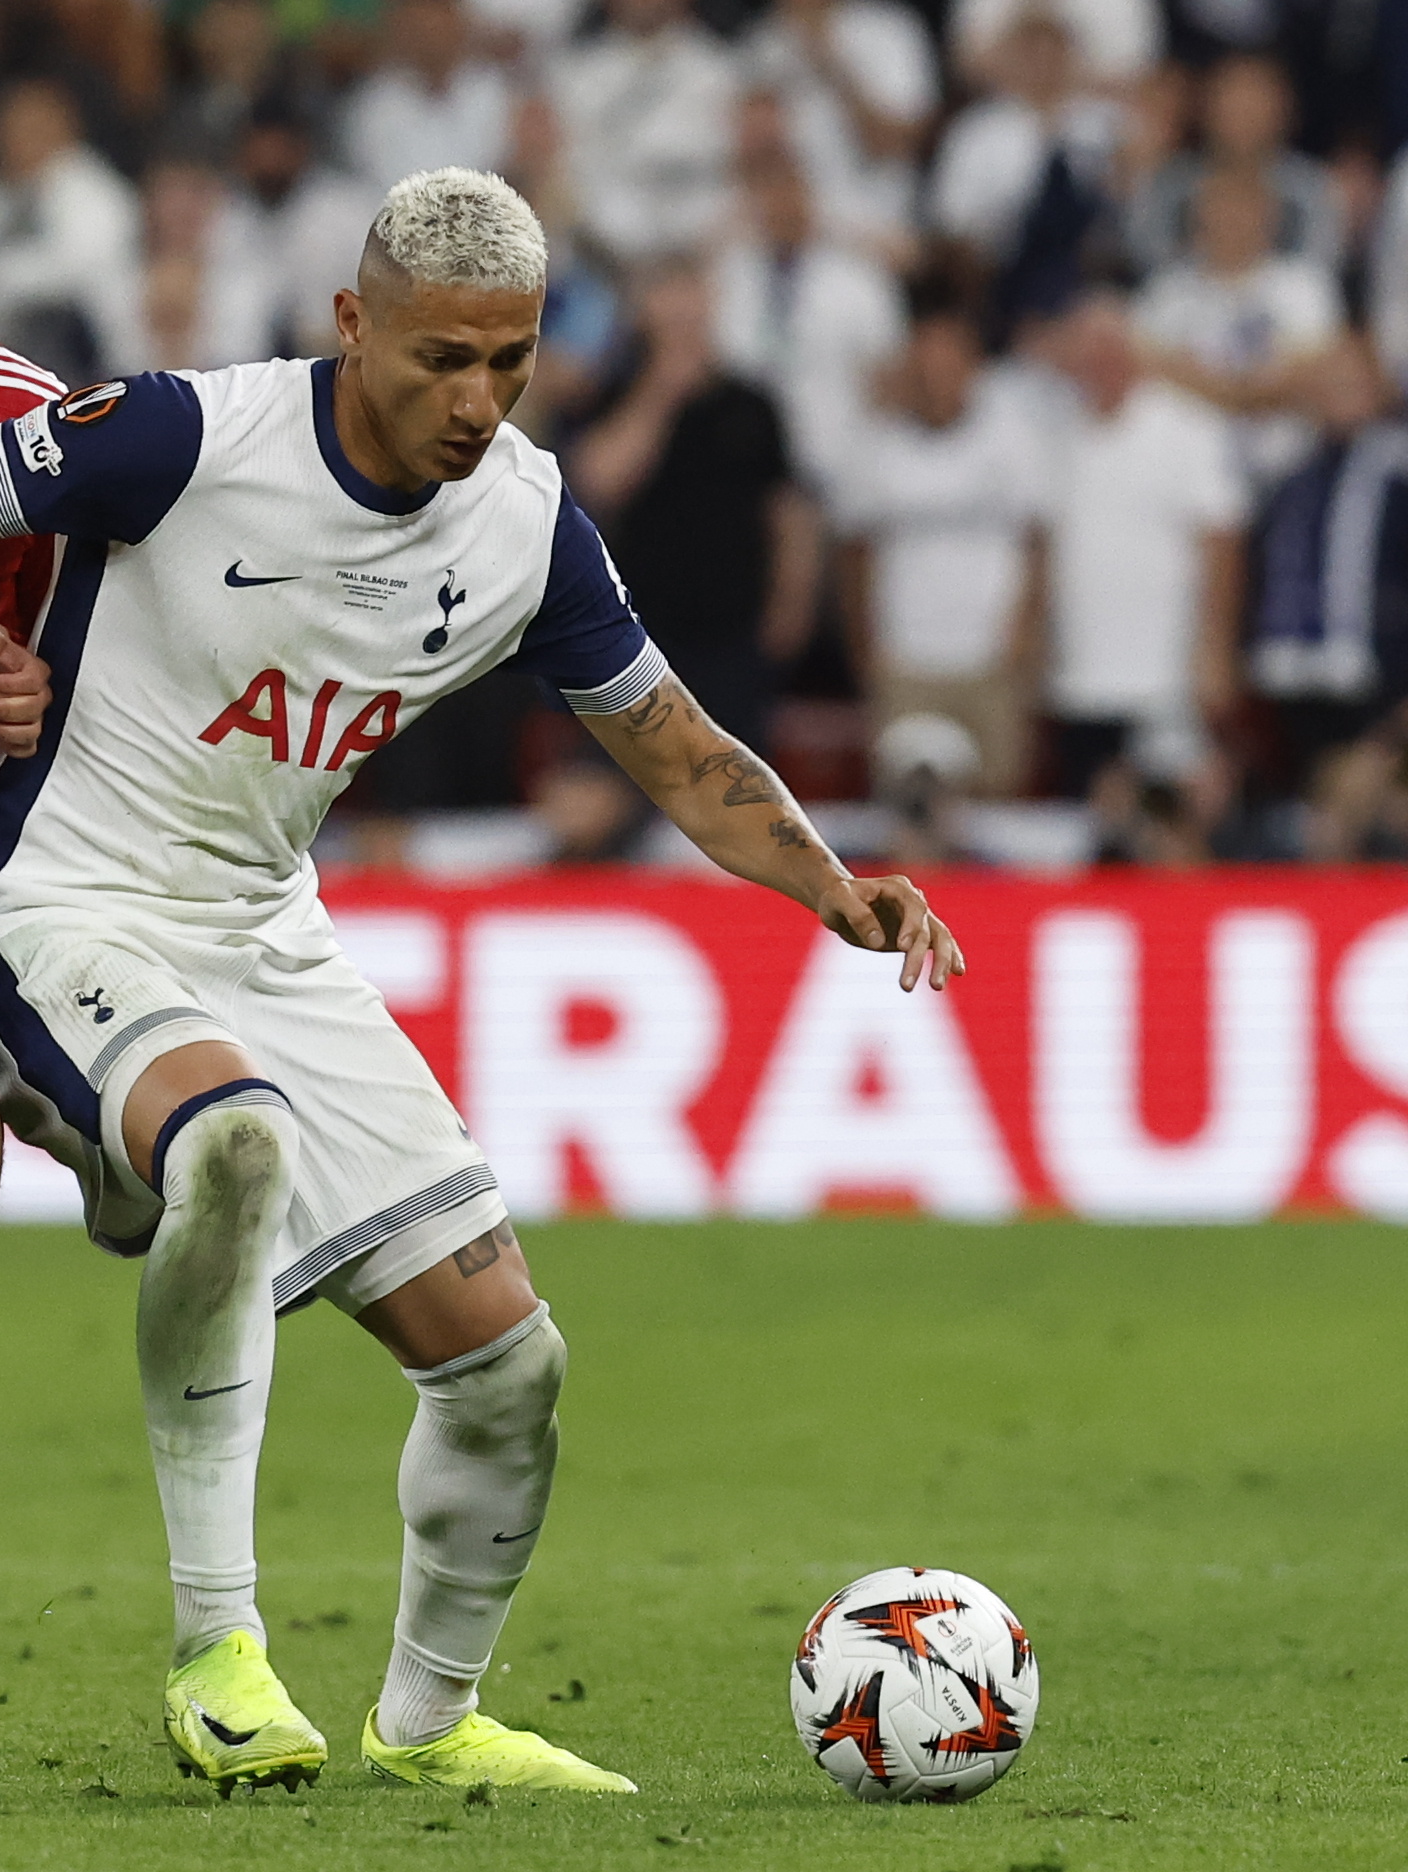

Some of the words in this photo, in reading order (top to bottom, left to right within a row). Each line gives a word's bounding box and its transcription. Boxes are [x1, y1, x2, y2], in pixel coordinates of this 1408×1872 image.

[336, 570, 359, 582] FINAL
[360, 574, 388, 586] BILBAO
[389, 579, 408, 589] 2025
[197, 668, 401, 771] AIA
[942, 1685, 967, 1723] KIPSTA
